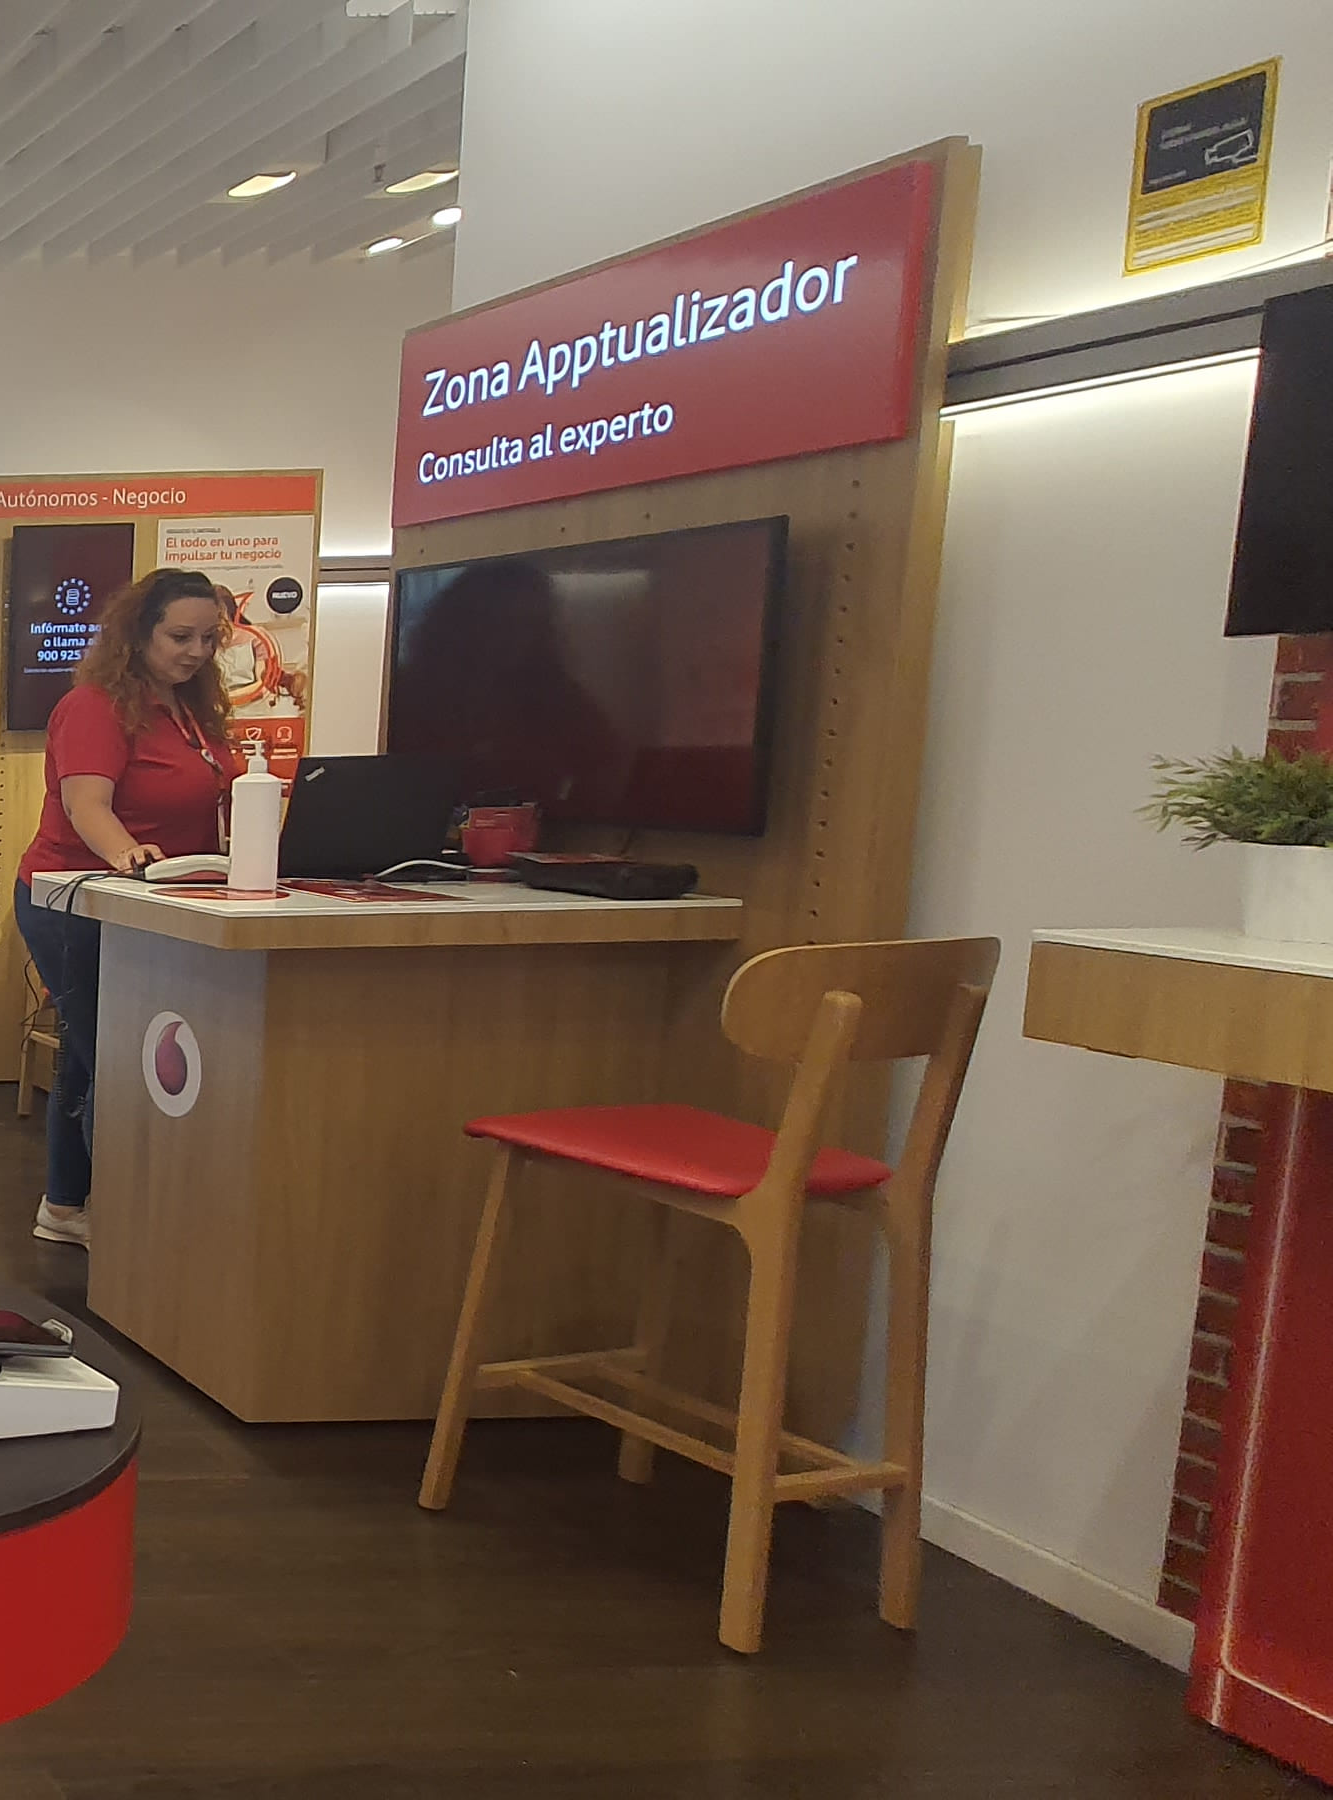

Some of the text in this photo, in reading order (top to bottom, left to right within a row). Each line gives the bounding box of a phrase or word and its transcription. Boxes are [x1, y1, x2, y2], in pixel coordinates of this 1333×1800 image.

[422, 254, 859, 417] Zona Apptualizador
[418, 401, 675, 485] Consulta al experto
[112, 487, 187, 509] Negocio
[165, 537, 279, 548] El todo en uno para
[165, 549, 282, 563] impulsar tu negocio
[30, 623, 87, 634] Infórmate
[44, 637, 86, 647] o llama
[37, 650, 82, 662] 900 925
